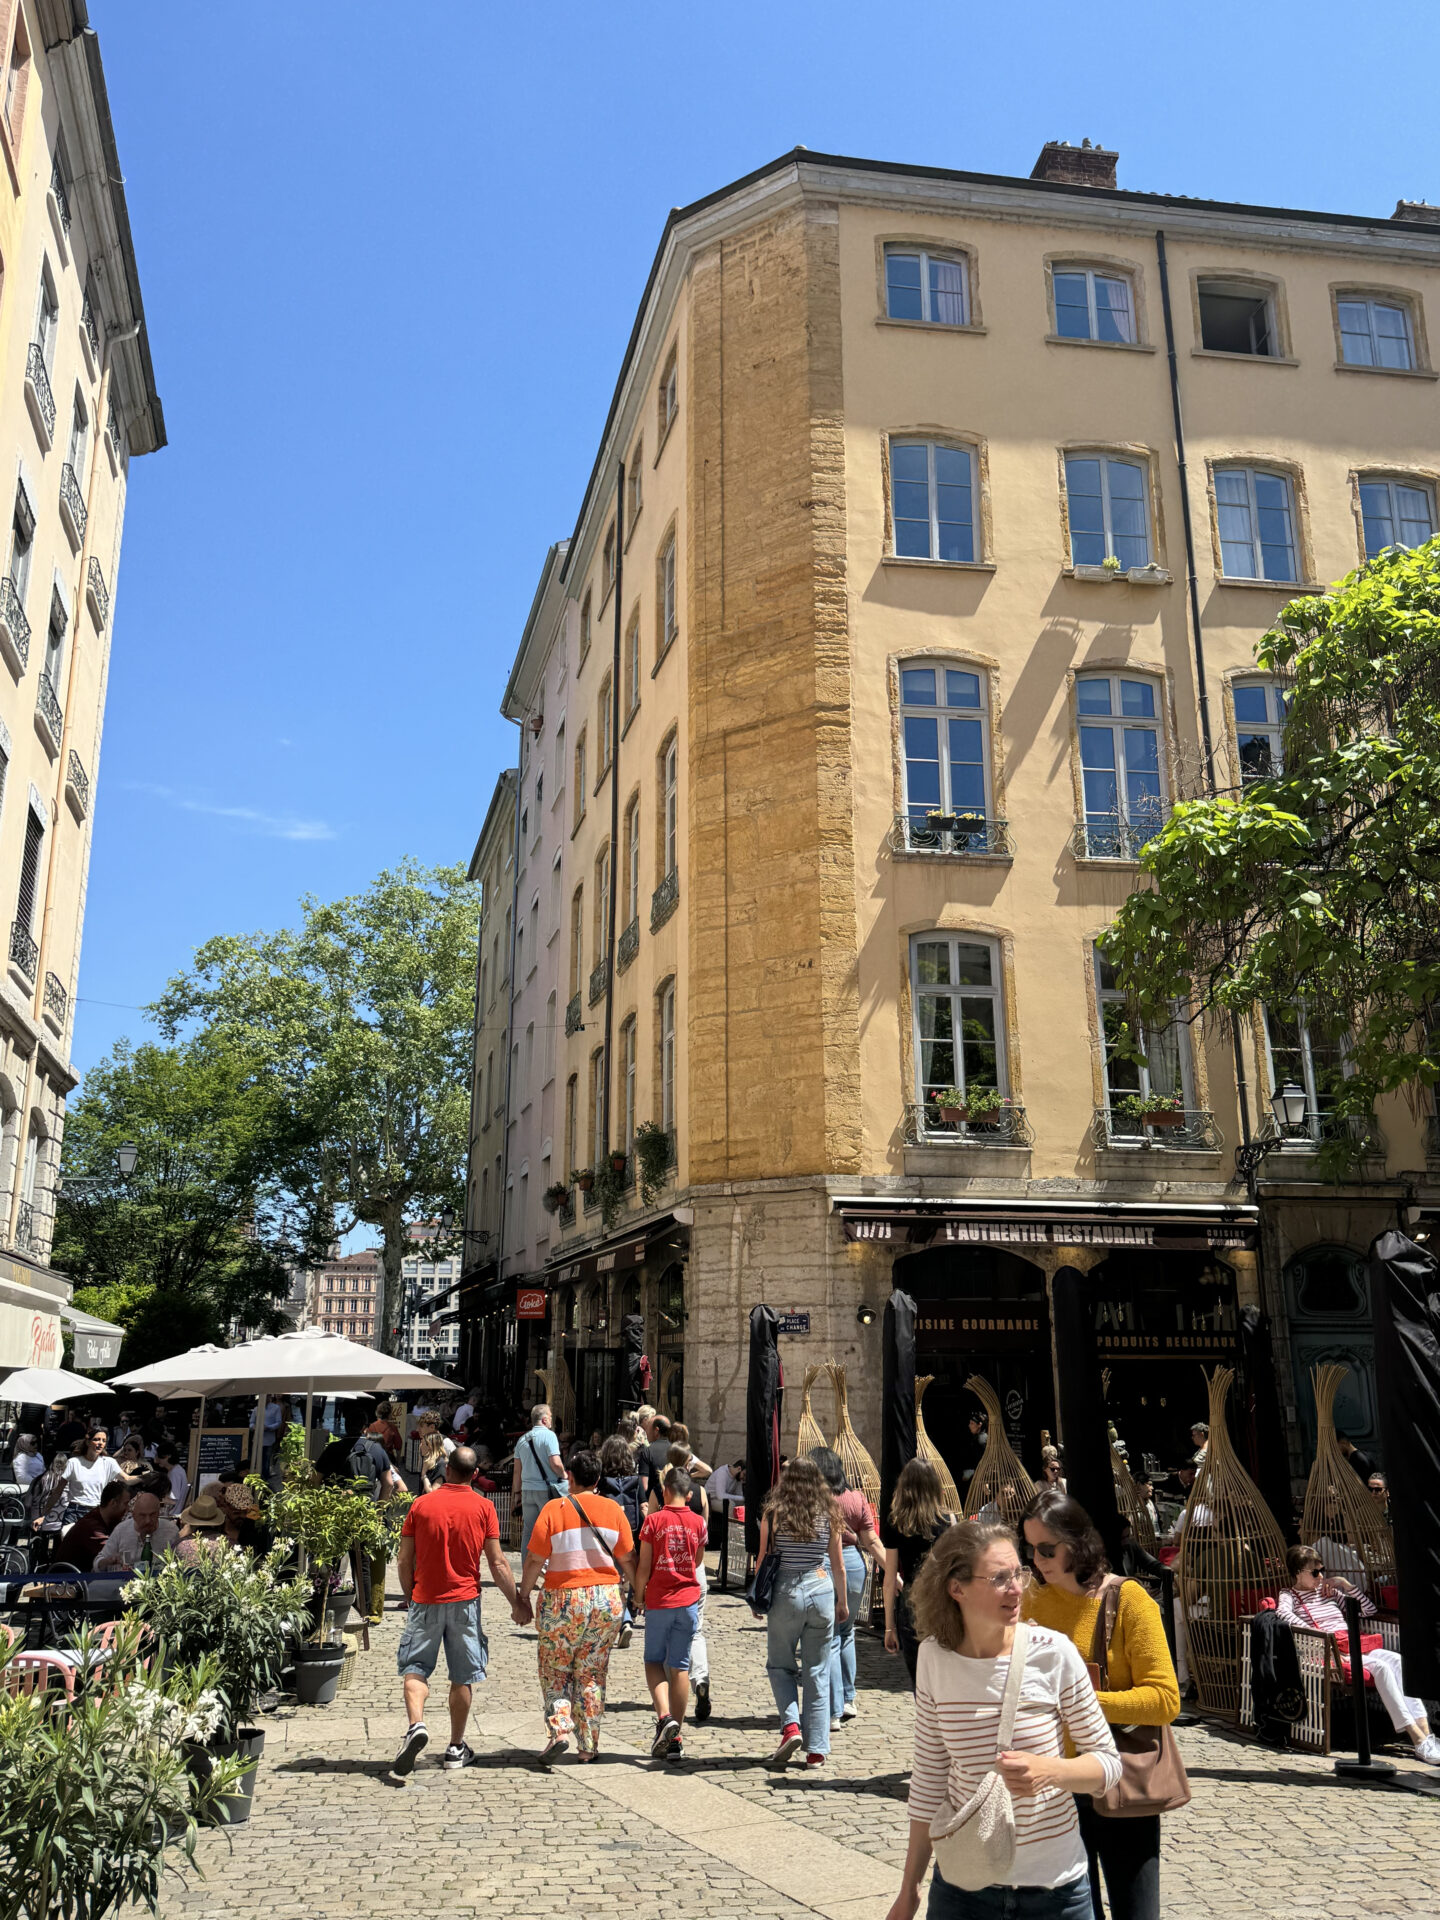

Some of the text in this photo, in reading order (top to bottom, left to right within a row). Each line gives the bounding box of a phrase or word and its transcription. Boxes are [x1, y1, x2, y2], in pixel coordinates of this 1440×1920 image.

[945, 1222, 1156, 1245] L'AUTHENTIK RESTAURANT
[913, 1318, 1039, 1330] ISINE GOURMANDE
[1096, 1336, 1237, 1348] PRODUITS REGIONAUX
